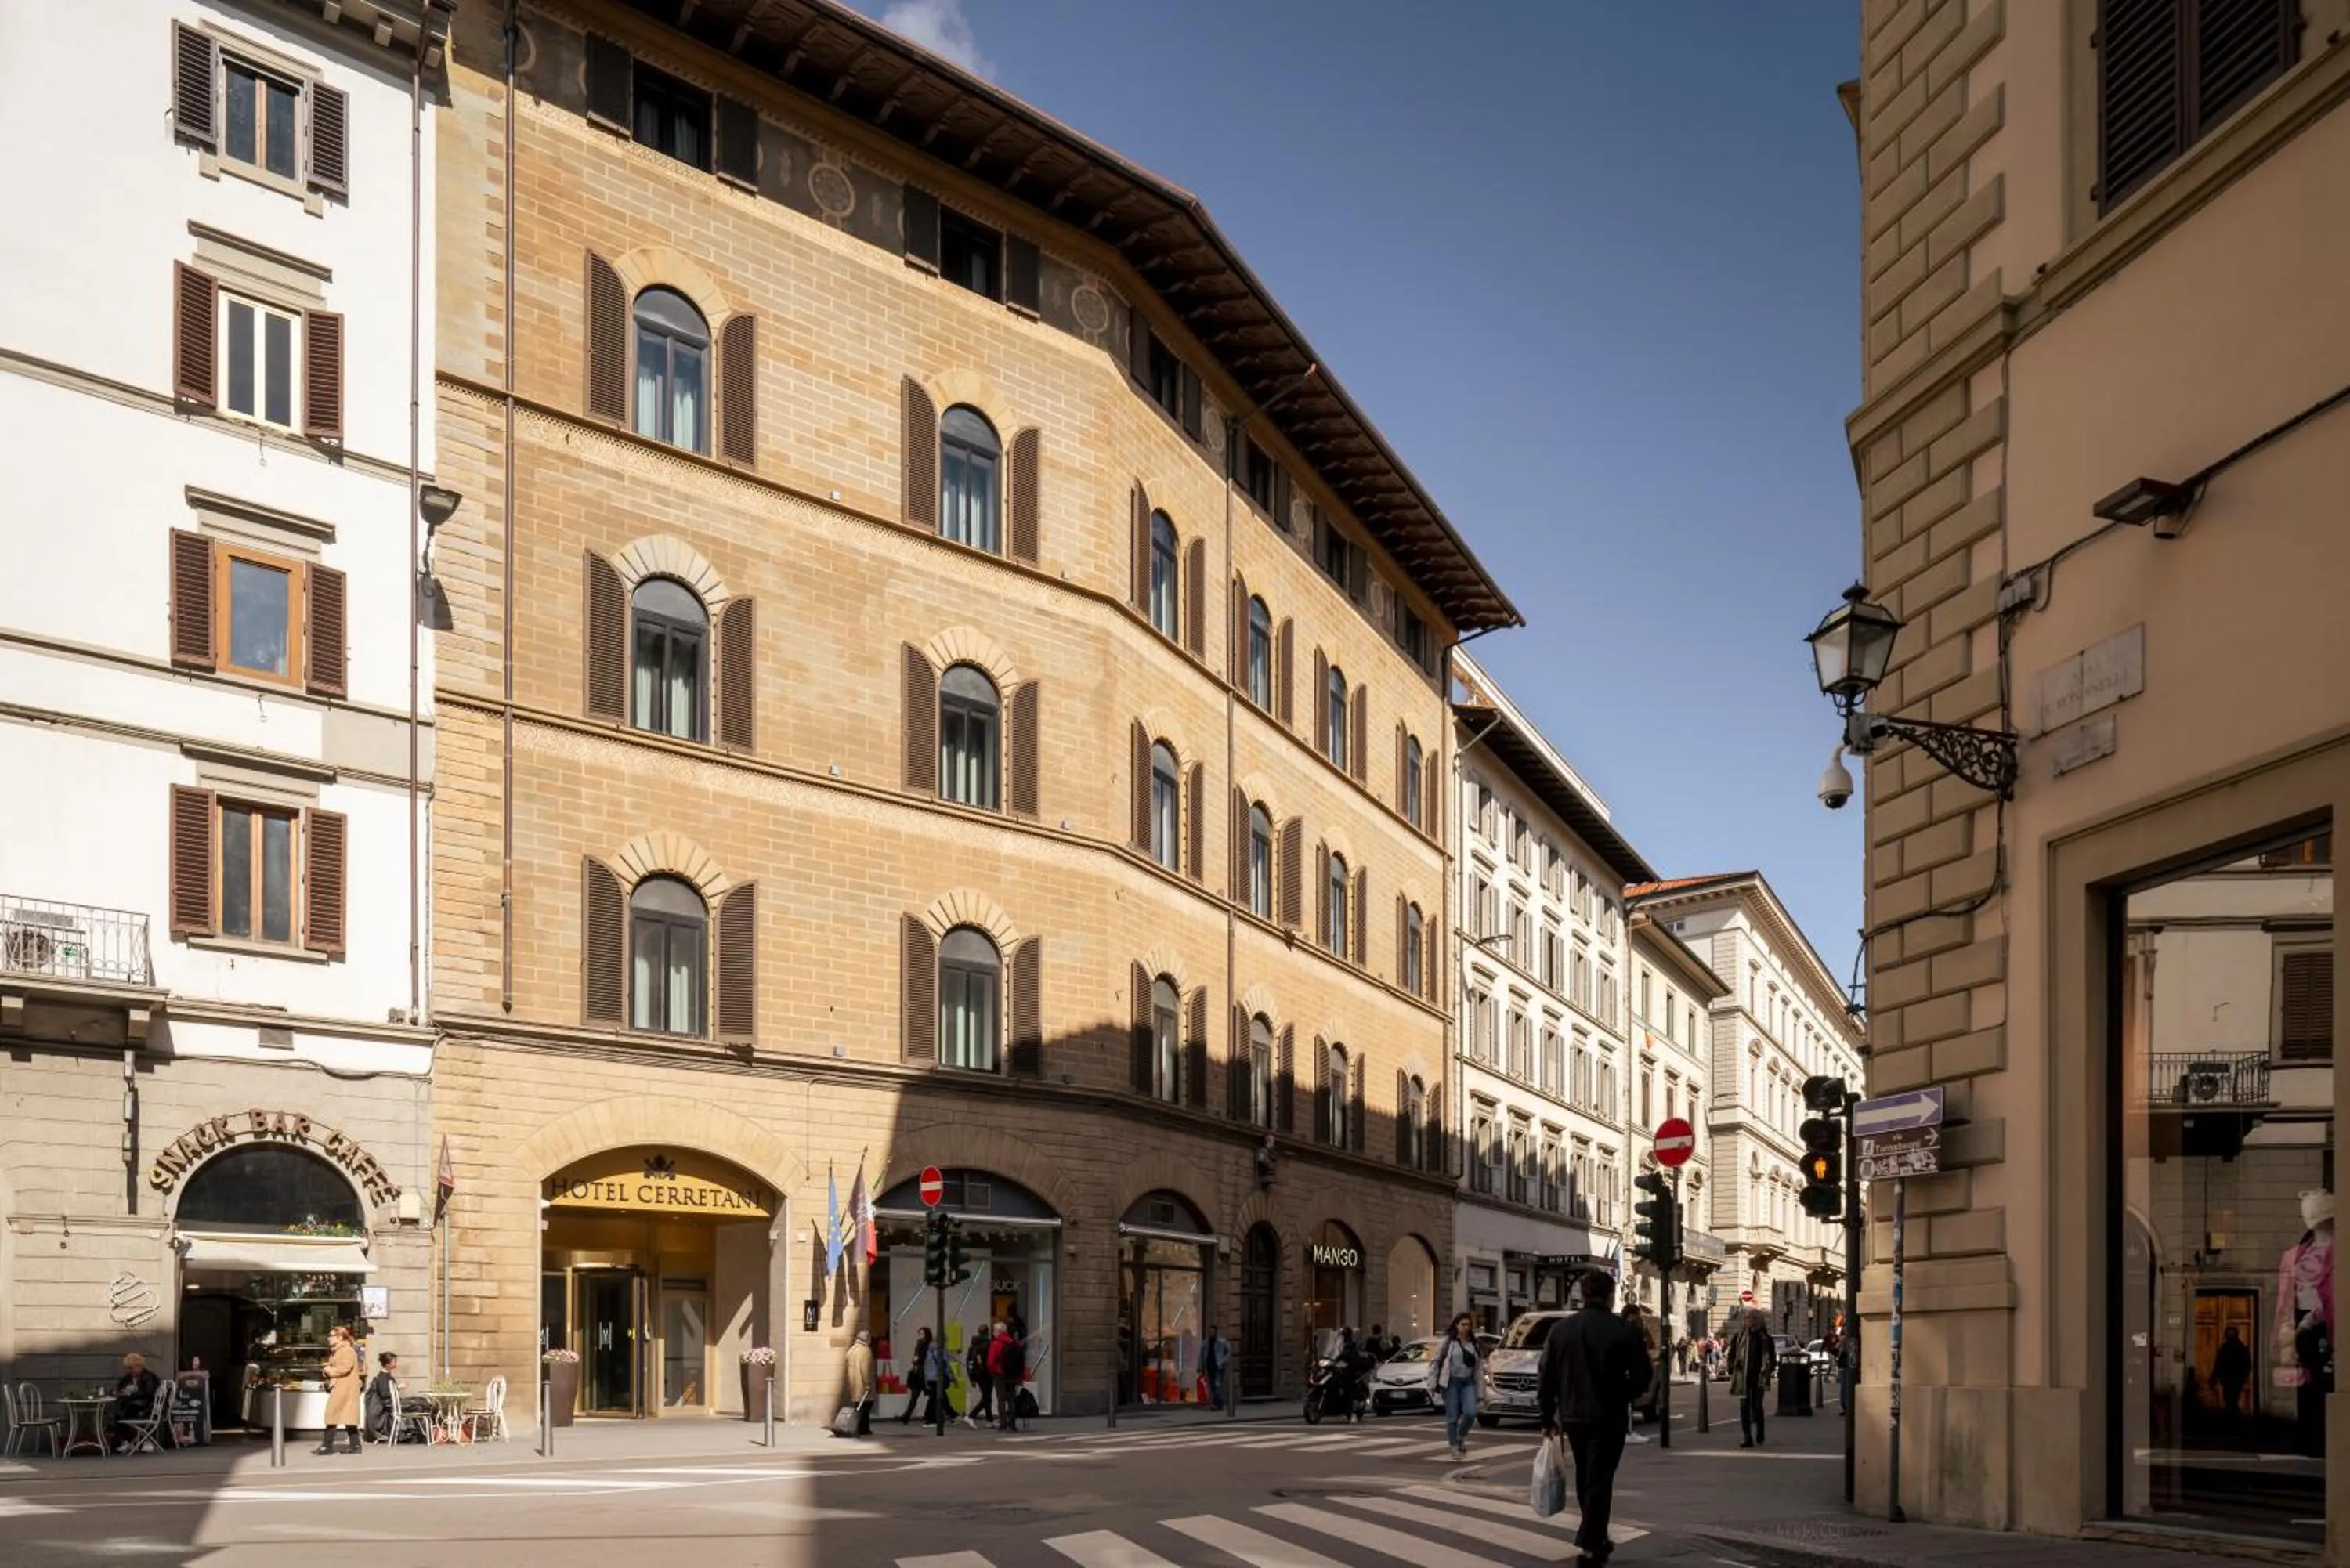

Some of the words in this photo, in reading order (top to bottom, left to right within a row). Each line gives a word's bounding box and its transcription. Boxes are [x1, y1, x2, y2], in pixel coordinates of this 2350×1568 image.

[149, 1113, 236, 1193] SNACK
[248, 1107, 312, 1141] BAR
[551, 1177, 630, 1202] HOTEL
[637, 1185, 763, 1210] CERRETANI
[1313, 1243, 1358, 1266] MANGO
